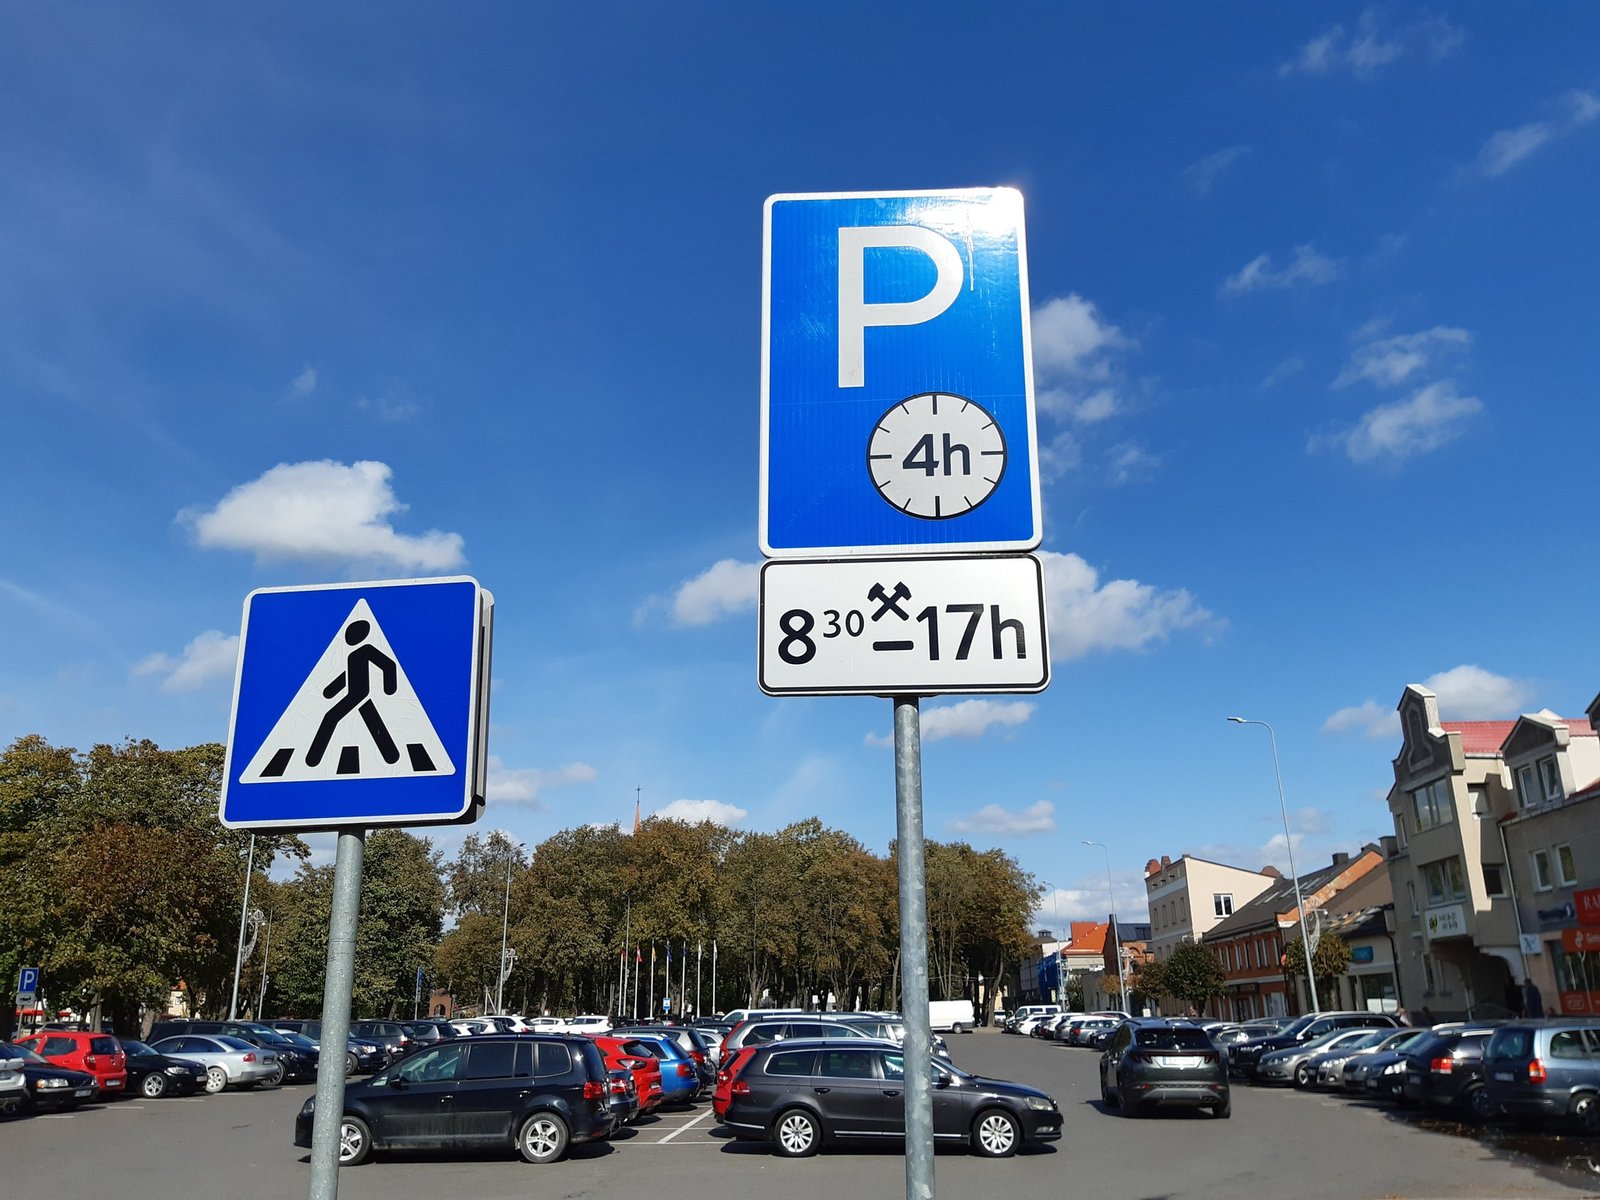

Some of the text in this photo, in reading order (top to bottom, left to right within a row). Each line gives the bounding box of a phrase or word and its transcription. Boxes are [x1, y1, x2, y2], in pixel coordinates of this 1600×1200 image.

[838, 225, 965, 388] P
[902, 433, 971, 477] 4h
[23, 971, 35, 990] P
